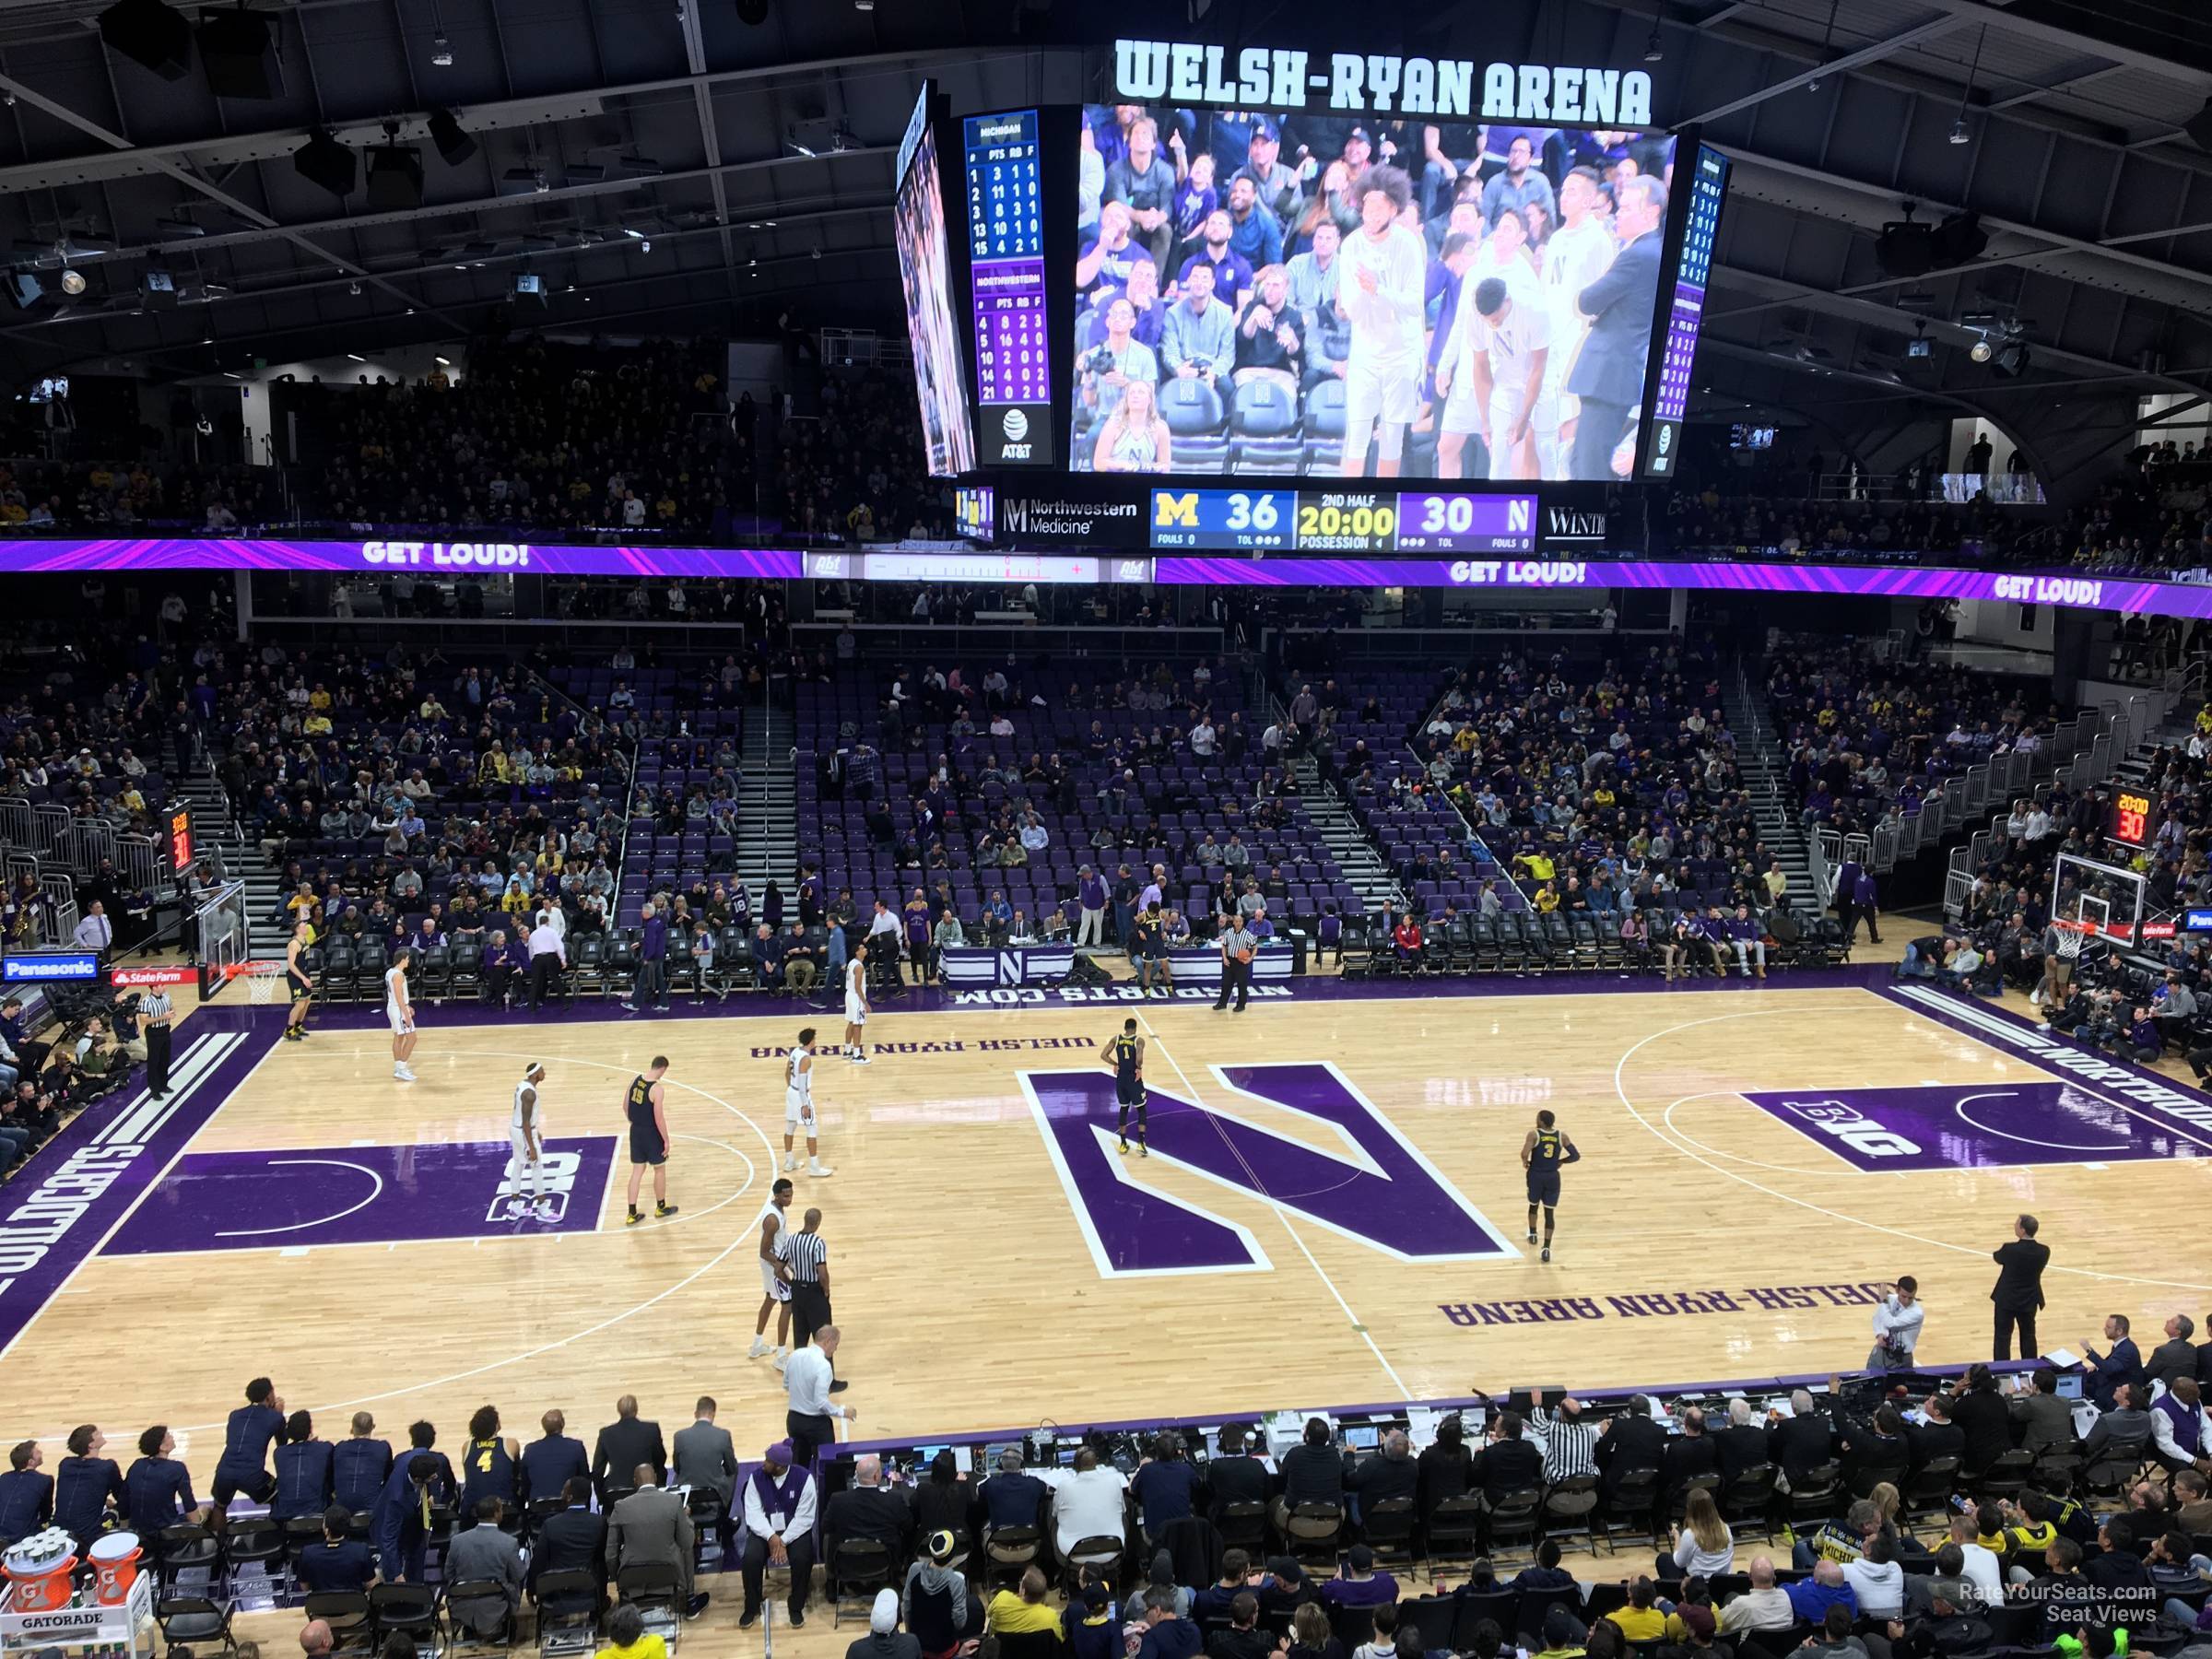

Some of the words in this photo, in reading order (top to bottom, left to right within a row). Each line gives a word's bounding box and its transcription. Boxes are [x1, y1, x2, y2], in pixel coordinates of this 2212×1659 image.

[1115, 40, 1473, 114] WELSH-RYAN
[1482, 63, 1652, 124] ARENA
[981, 124, 1021, 137] MICHIGAN
[989, 149, 1006, 160] PTS
[1028, 146, 1034, 156] F
[971, 169, 977, 182] 1
[994, 167, 1002, 181] 3
[1012, 164, 1019, 179] 1
[1028, 163, 1034, 177] 1
[971, 187, 980, 201] 2
[992, 184, 1005, 199] 11
[1013, 183, 1020, 197] 1
[1029, 182, 1036, 195] 0
[973, 206, 980, 219] 3
[995, 204, 1004, 218] 8
[1014, 202, 1021, 216] 3
[1030, 200, 1036, 214] 1
[973, 223, 986, 237] 13
[994, 221, 1006, 235] 10
[1015, 220, 1021, 233] 1
[1030, 218, 1038, 232] 0
[974, 241, 987, 254] 15
[997, 240, 1006, 253] 4
[1016, 238, 1023, 253] 2
[1031, 237, 1038, 251] 1
[977, 274, 1041, 286] NORTHWESTERN
[996, 299, 1013, 309] PTS
[1034, 296, 1041, 306] F
[979, 317, 987, 330] 4
[1001, 315, 1009, 329] 8
[1019, 314, 1028, 328] 2
[1035, 313, 1041, 327] 3
[981, 335, 988, 347] 5
[1000, 333, 1013, 347] 16
[1020, 333, 1028, 346] 4
[1036, 332, 1043, 346] 0
[981, 352, 994, 364] 10
[1004, 351, 1011, 364] 2
[1021, 350, 1030, 363] 0
[1037, 349, 1044, 363] 0
[982, 370, 994, 382] 14
[1005, 369, 1012, 381] 4
[1022, 368, 1030, 381] 0
[1038, 368, 1045, 381] 2
[983, 387, 994, 399] 21
[1005, 386, 1013, 399] 0
[1023, 385, 1030, 398] 2
[1038, 384, 1045, 398] 0
[1002, 444, 1031, 459] AT&T
[1031, 500, 1137, 516] Northwestern
[1322, 494, 1345, 507] 2ND
[1347, 495, 1376, 508] HALF
[1156, 493, 1199, 526] M
[1226, 493, 1278, 531] 36
[1421, 496, 1474, 533] 30
[1508, 500, 1530, 532] N
[1300, 506, 1394, 536] 20:00
[1158, 534, 1183, 544] FOULS
[1188, 535, 1195, 546] 0
[1238, 535, 1253, 546] TOL
[1300, 536, 1370, 548] POSSESSION
[1438, 537, 1453, 547] TOL
[1492, 537, 1517, 548] FOULS
[1523, 539, 1529, 549] 0
[362, 541, 425, 564] GET
[433, 542, 529, 567] LOUD!
[1450, 560, 1502, 582] GET
[1507, 561, 1587, 583] LOUD!
[1994, 576, 2034, 599] GET
[2036, 578, 2102, 606] LOUD!
[2119, 794, 2149, 816] 20:00
[2120, 810, 2145, 841] 30
[734, 899, 747, 913] 18
[6, 960, 95, 976] Panasonic
[1000, 951, 1022, 984] N
[874, 1037, 1098, 1054] WELSH-RYAN
[1124, 1046, 1130, 1060] 1
[631, 1088, 645, 1105] 15
[1544, 1144, 1554, 1159] 3
[0, 1145, 145, 1274] WILDCATS
[1438, 1296, 1606, 1326] ARENA
[477, 1450, 492, 1473] 4
[101, 1570, 115, 1584] G
[20, 1583, 36, 1599] G
[22, 1614, 103, 1629] GATORADE
